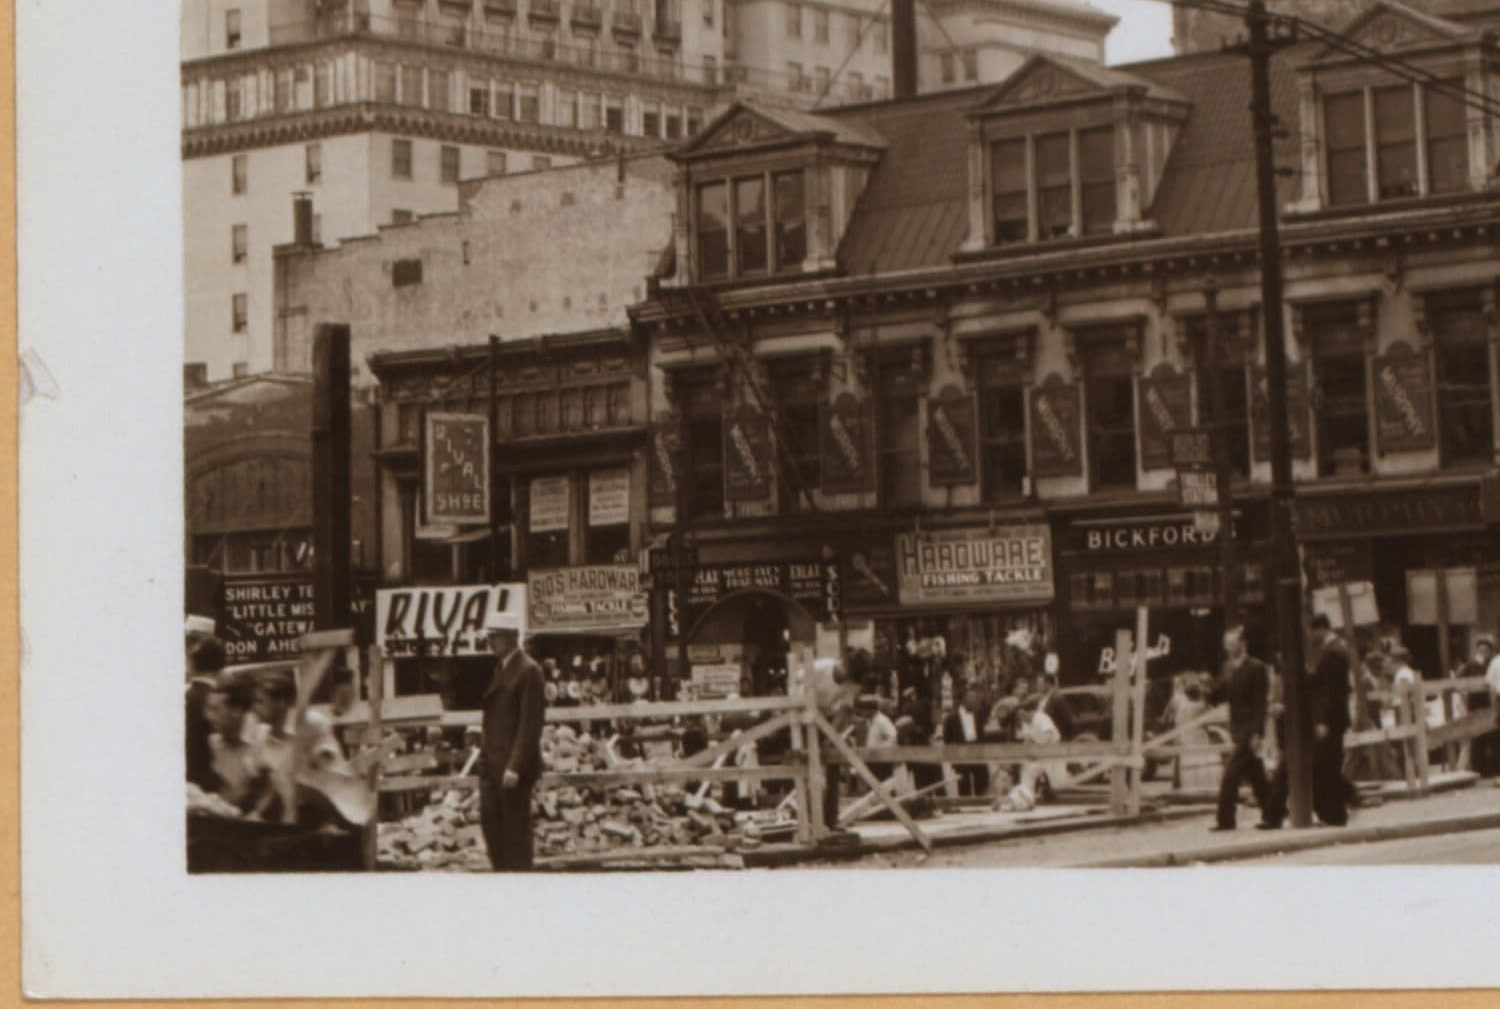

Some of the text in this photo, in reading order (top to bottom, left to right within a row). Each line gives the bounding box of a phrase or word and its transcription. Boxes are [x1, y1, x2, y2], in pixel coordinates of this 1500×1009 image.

[901, 536, 1045, 576] HARDWARE
[568, 568, 638, 592] HARDWAR
[922, 568, 1043, 588] FISHING TACKLE
[225, 584, 314, 602] SHIRLEY TE
[290, 602, 315, 616] MIS
[225, 638, 299, 655] DON AME
